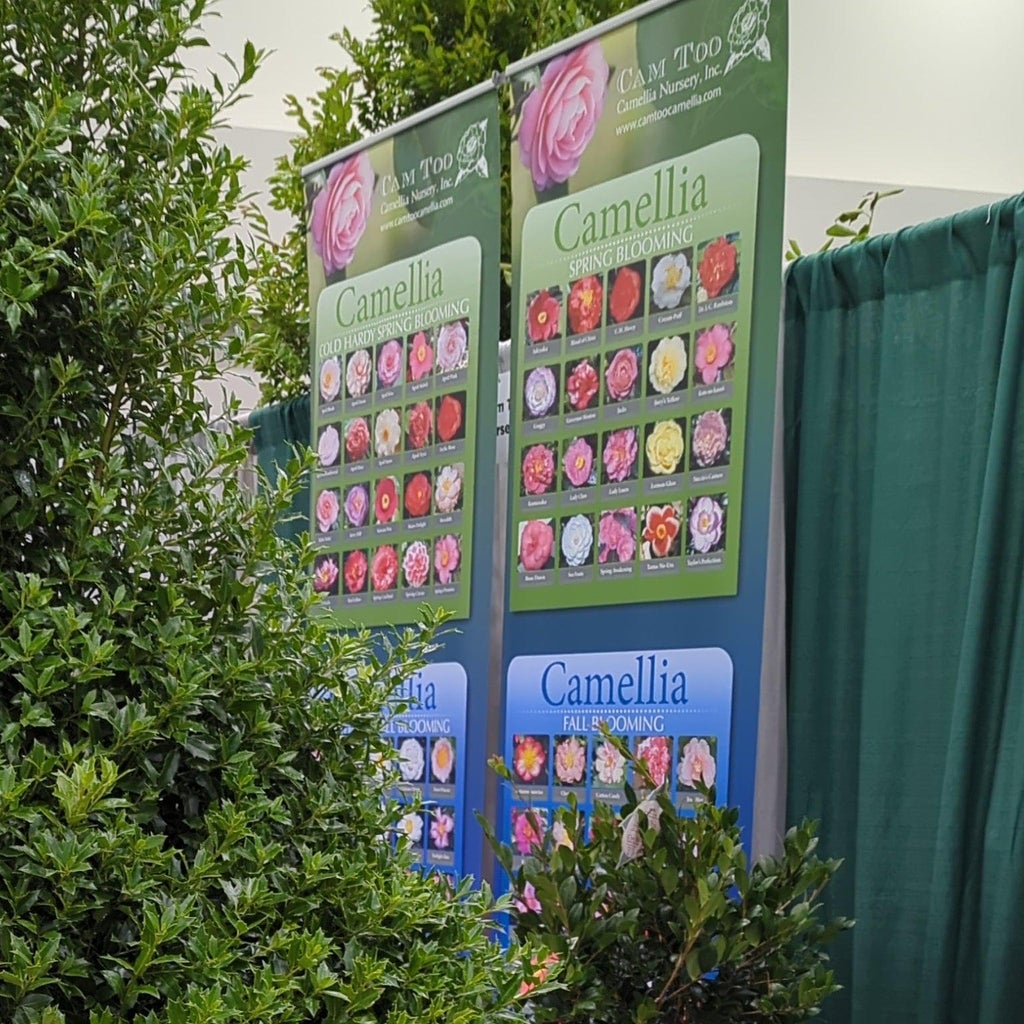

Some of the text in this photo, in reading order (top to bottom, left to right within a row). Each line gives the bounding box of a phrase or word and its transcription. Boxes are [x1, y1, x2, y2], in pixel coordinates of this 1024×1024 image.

[616, 63, 723, 114] Camellia Nursery, Inc.
[616, 86, 722, 136] www.camtoocamellia.com
[554, 164, 708, 252] Camellia
[569, 225, 693, 278] SPRING BLOOMING
[336, 259, 444, 327] Camellia
[319, 298, 470, 358] COLD HARDY SPRING BLOOMING
[541, 655, 689, 706] Camellia
[563, 715, 664, 732] FALL BOOMING
